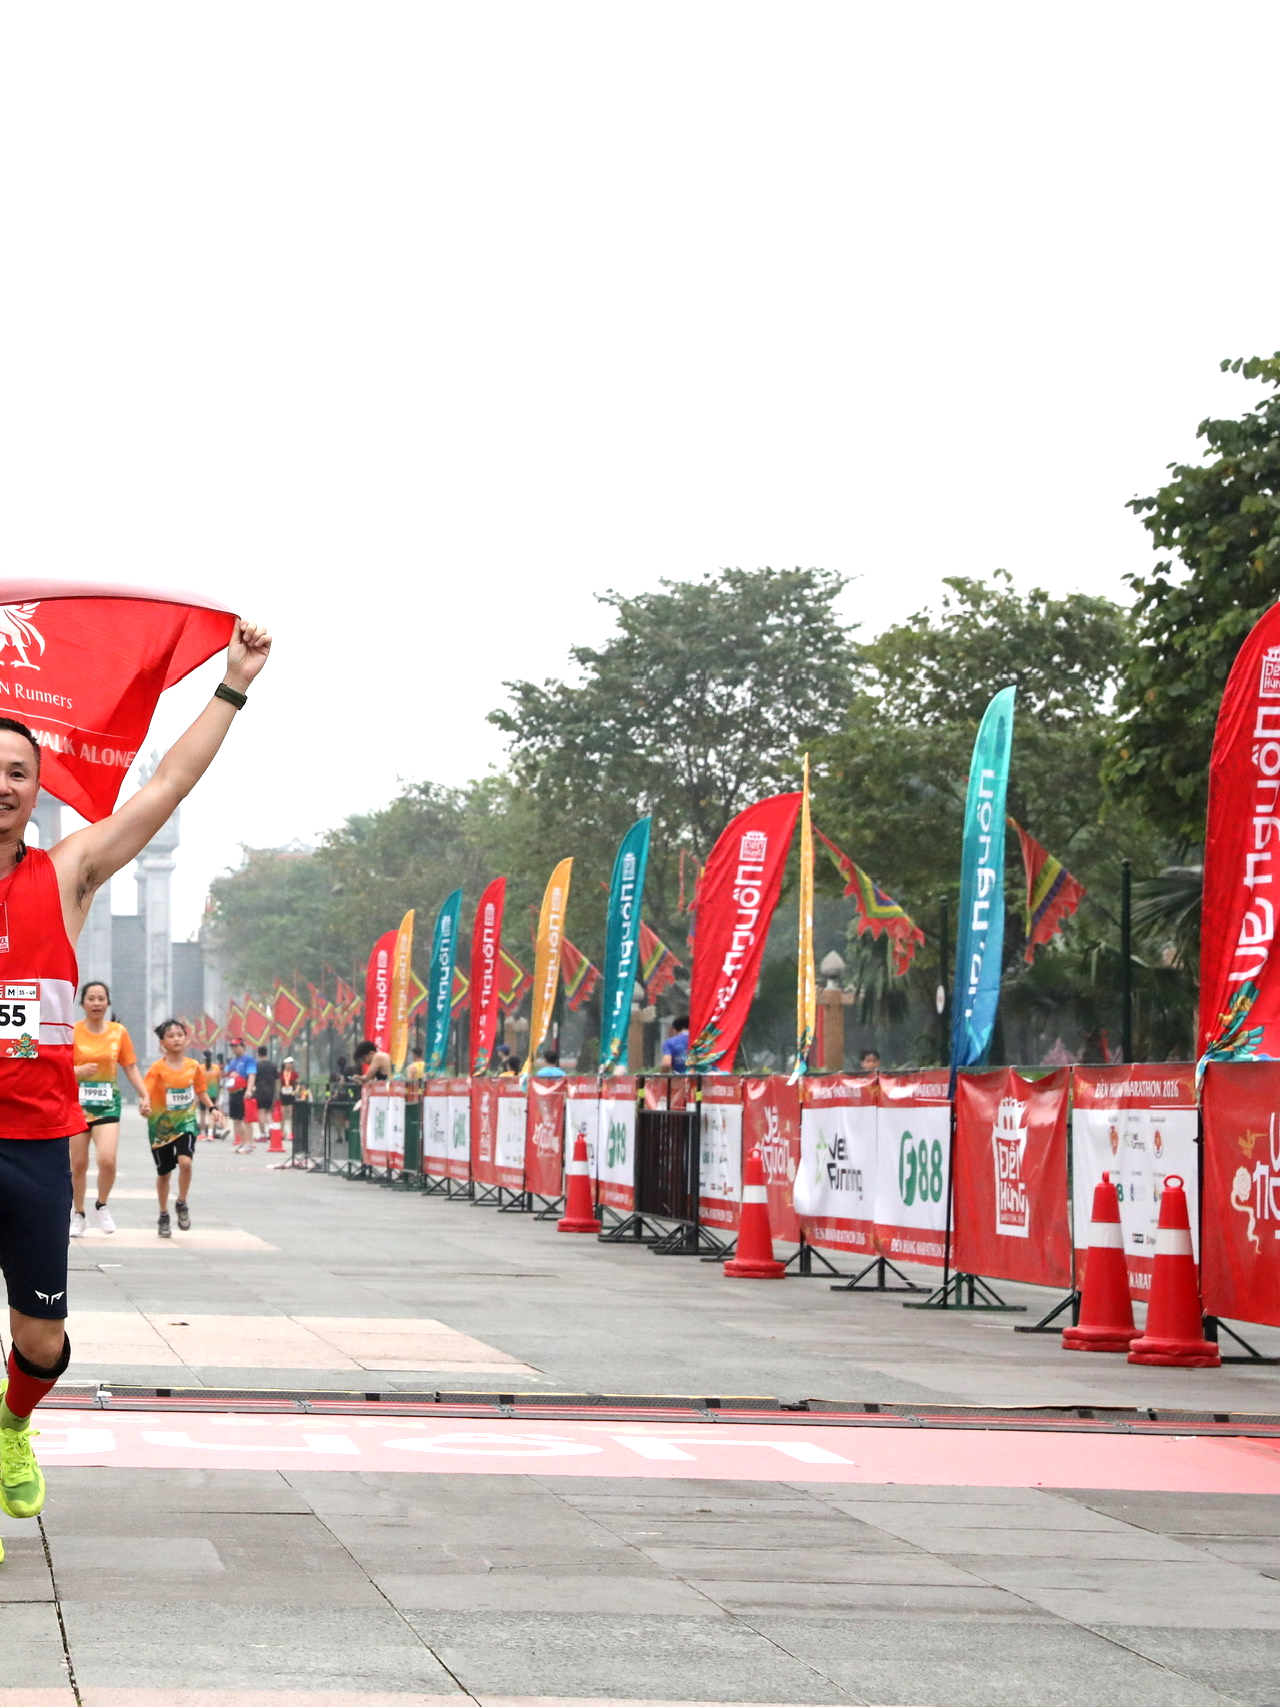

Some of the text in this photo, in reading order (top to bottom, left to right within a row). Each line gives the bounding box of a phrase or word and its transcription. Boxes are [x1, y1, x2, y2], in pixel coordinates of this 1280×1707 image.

[15, 683, 73, 709] Runners
[84, 1088, 107, 1097] 19982
[898, 1130, 943, 1207] F88
[208, 1417, 430, 1430] BẠN
